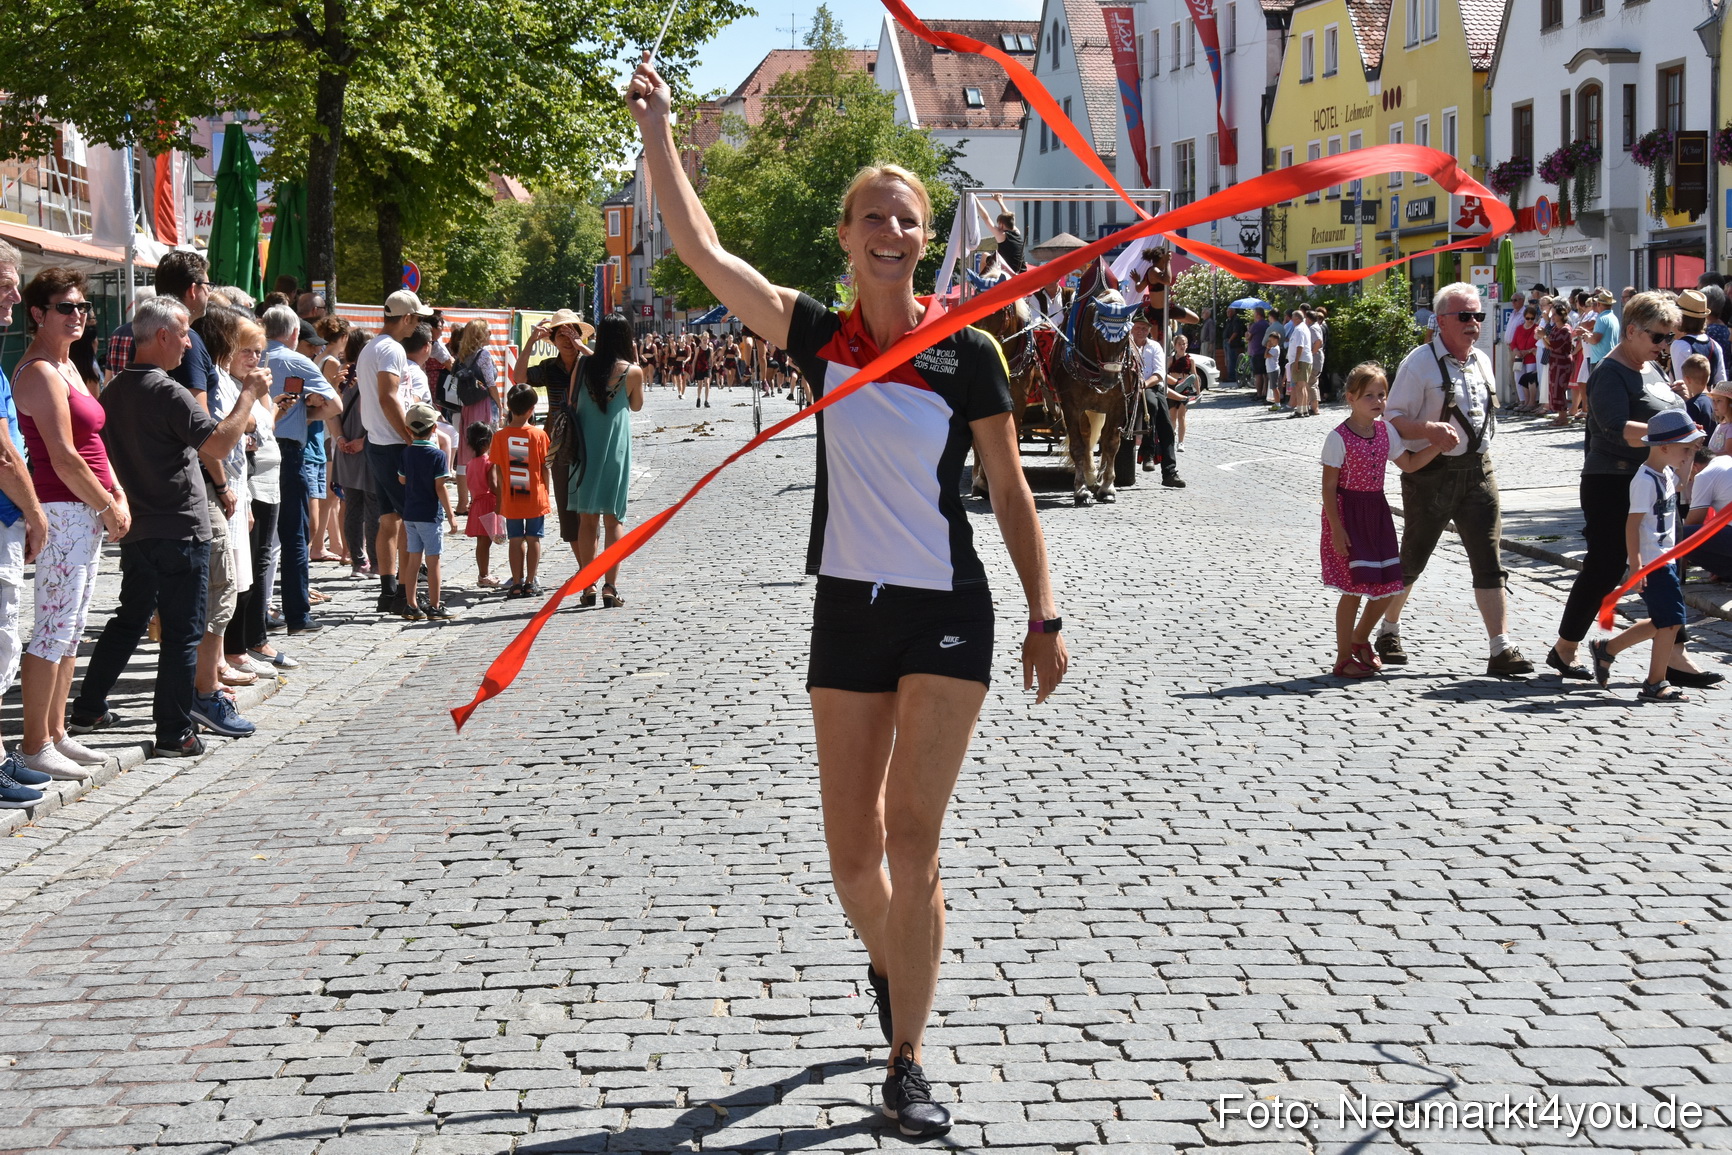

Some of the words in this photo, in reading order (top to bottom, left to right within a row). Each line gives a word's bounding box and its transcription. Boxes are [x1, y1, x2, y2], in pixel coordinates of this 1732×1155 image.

[1313, 106, 1338, 132] HOTEL
[1344, 101, 1373, 123] Lehmeier
[1392, 200, 1398, 226] P
[1404, 200, 1429, 218] TAIFUN
[1342, 214, 1375, 222] TAUN
[1311, 227, 1346, 244] Restaurant
[936, 349, 956, 358] WORLD
[914, 360, 929, 370] 2015
[929, 364, 957, 375] HELSINKI
[508, 436, 531, 496] PUMA
[943, 635, 960, 643] NIKE
